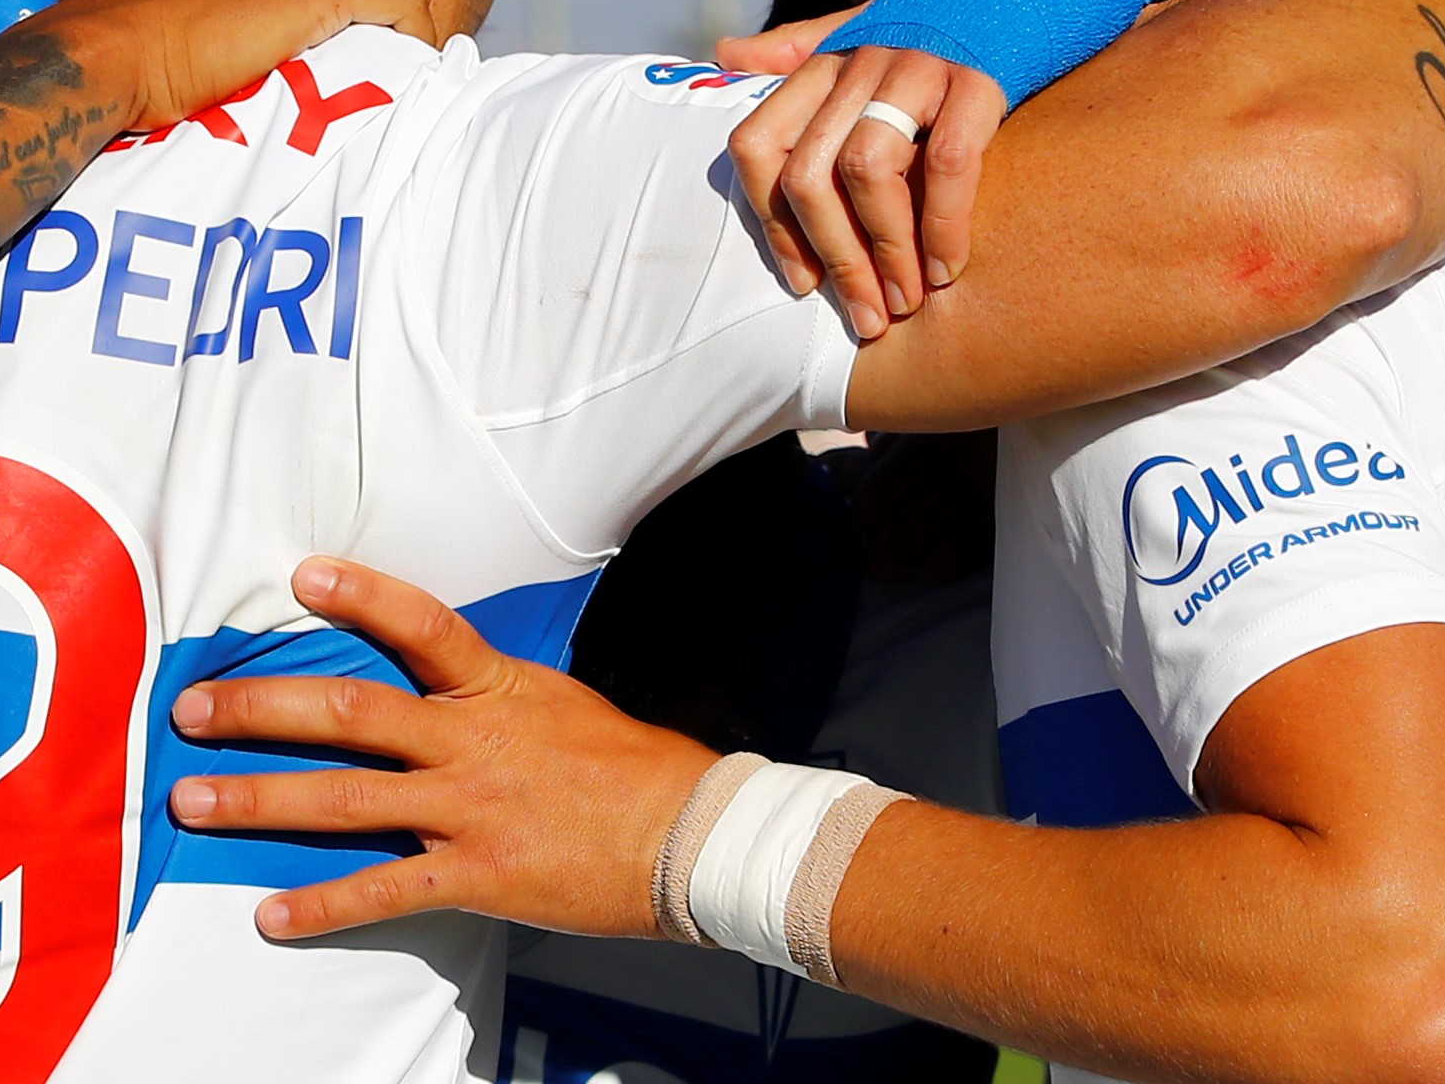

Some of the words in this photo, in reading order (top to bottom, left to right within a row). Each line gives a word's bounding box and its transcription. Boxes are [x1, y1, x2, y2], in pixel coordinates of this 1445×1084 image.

[1122, 433, 1406, 586] Midea
[1173, 542, 1274, 627] UNDER
[1281, 511, 1421, 554] ARMOUR
